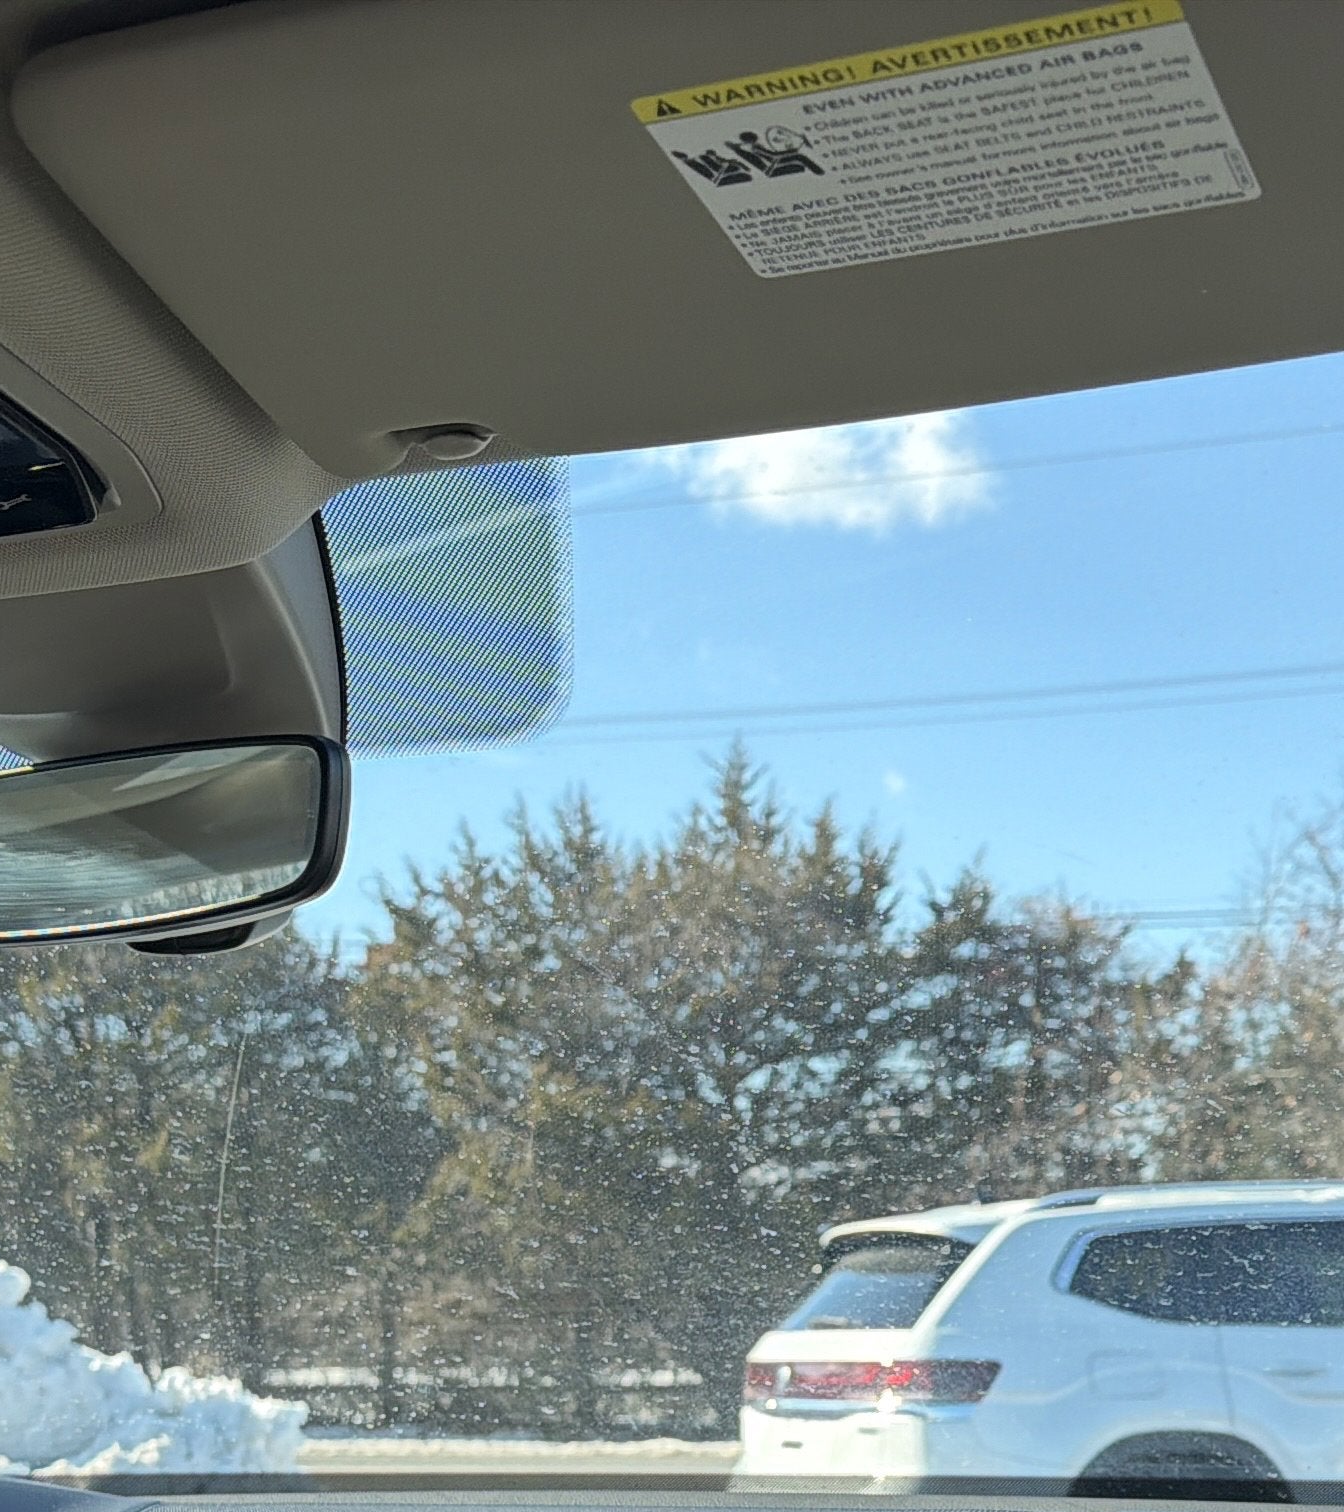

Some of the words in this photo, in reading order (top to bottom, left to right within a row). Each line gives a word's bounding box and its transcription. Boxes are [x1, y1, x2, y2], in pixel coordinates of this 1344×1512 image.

[692, 65, 854, 108] WARNING!
[871, 7, 1154, 75] AVERTISSEMENT!
[801, 95, 854, 114] EVEN
[859, 84, 913, 104] WITH
[917, 61, 1033, 93] ADVANCED
[1036, 54, 1075, 71] AIR
[1081, 41, 1143, 63] BAGS
[729, 205, 785, 222] MÊME
[789, 195, 840, 212] AVEC
[843, 188, 882, 203] DES
[884, 178, 937, 196] SACS
[940, 156, 1069, 186] GONFLABLES
[1074, 139, 1166, 163] ÉVOLUÉS
